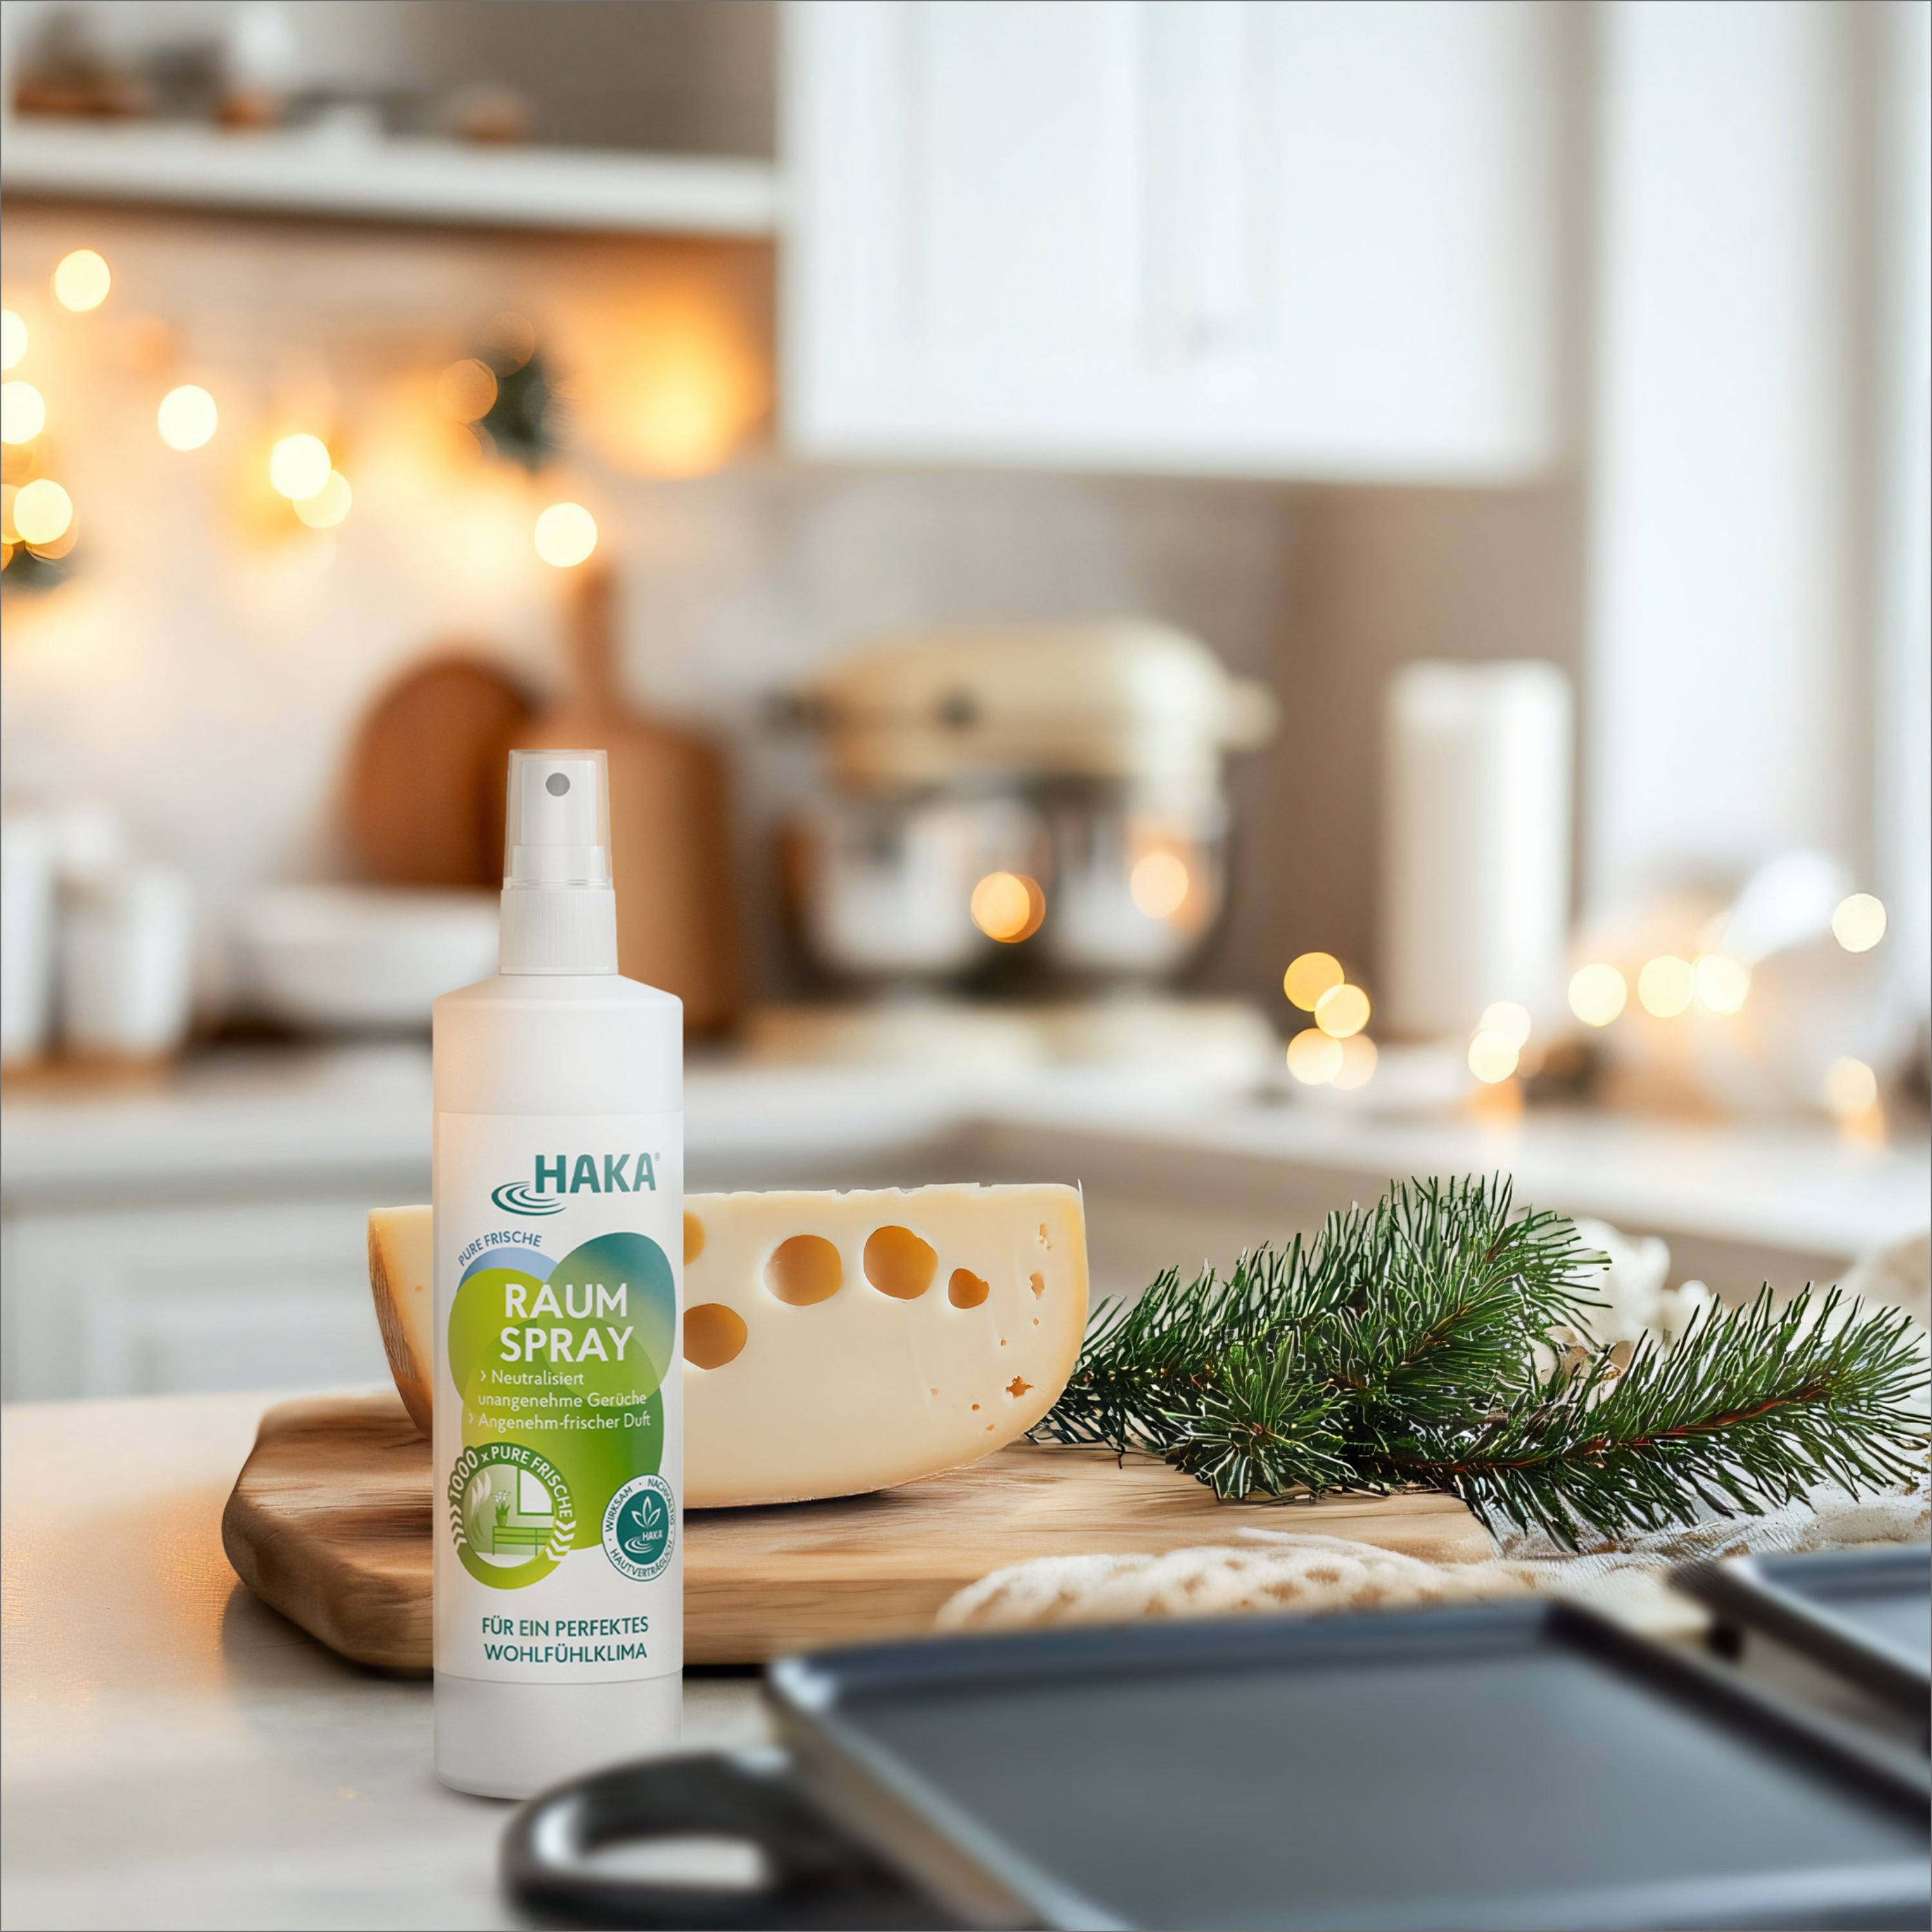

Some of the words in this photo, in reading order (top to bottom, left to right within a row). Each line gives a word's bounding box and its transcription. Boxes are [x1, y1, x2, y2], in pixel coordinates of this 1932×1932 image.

[457, 1238, 484, 1267] PURE
[484, 1231, 542, 1247] FRISCHE
[506, 1283, 627, 1318] RAUM
[500, 1326, 634, 1362] SPRAY
[491, 1370, 584, 1385] Neutralisiert
[478, 1394, 582, 1411] unangenehme
[587, 1390, 647, 1407] Gerüche
[478, 1414, 620, 1433] Angenehm-frischer
[624, 1410, 651, 1428] Duft
[450, 1450, 478, 1499] 1000
[491, 1446, 531, 1465] PURE
[530, 1457, 573, 1518] FRISCHE
[605, 1485, 633, 1533] WIRKSAM
[642, 1530, 663, 1541] HAKA
[482, 1615, 514, 1636] FÜR
[519, 1620, 549, 1636] EIN
[556, 1616, 649, 1636] PERFEKTES
[484, 1642, 647, 1663] WOHLFÜHLKLIMA
